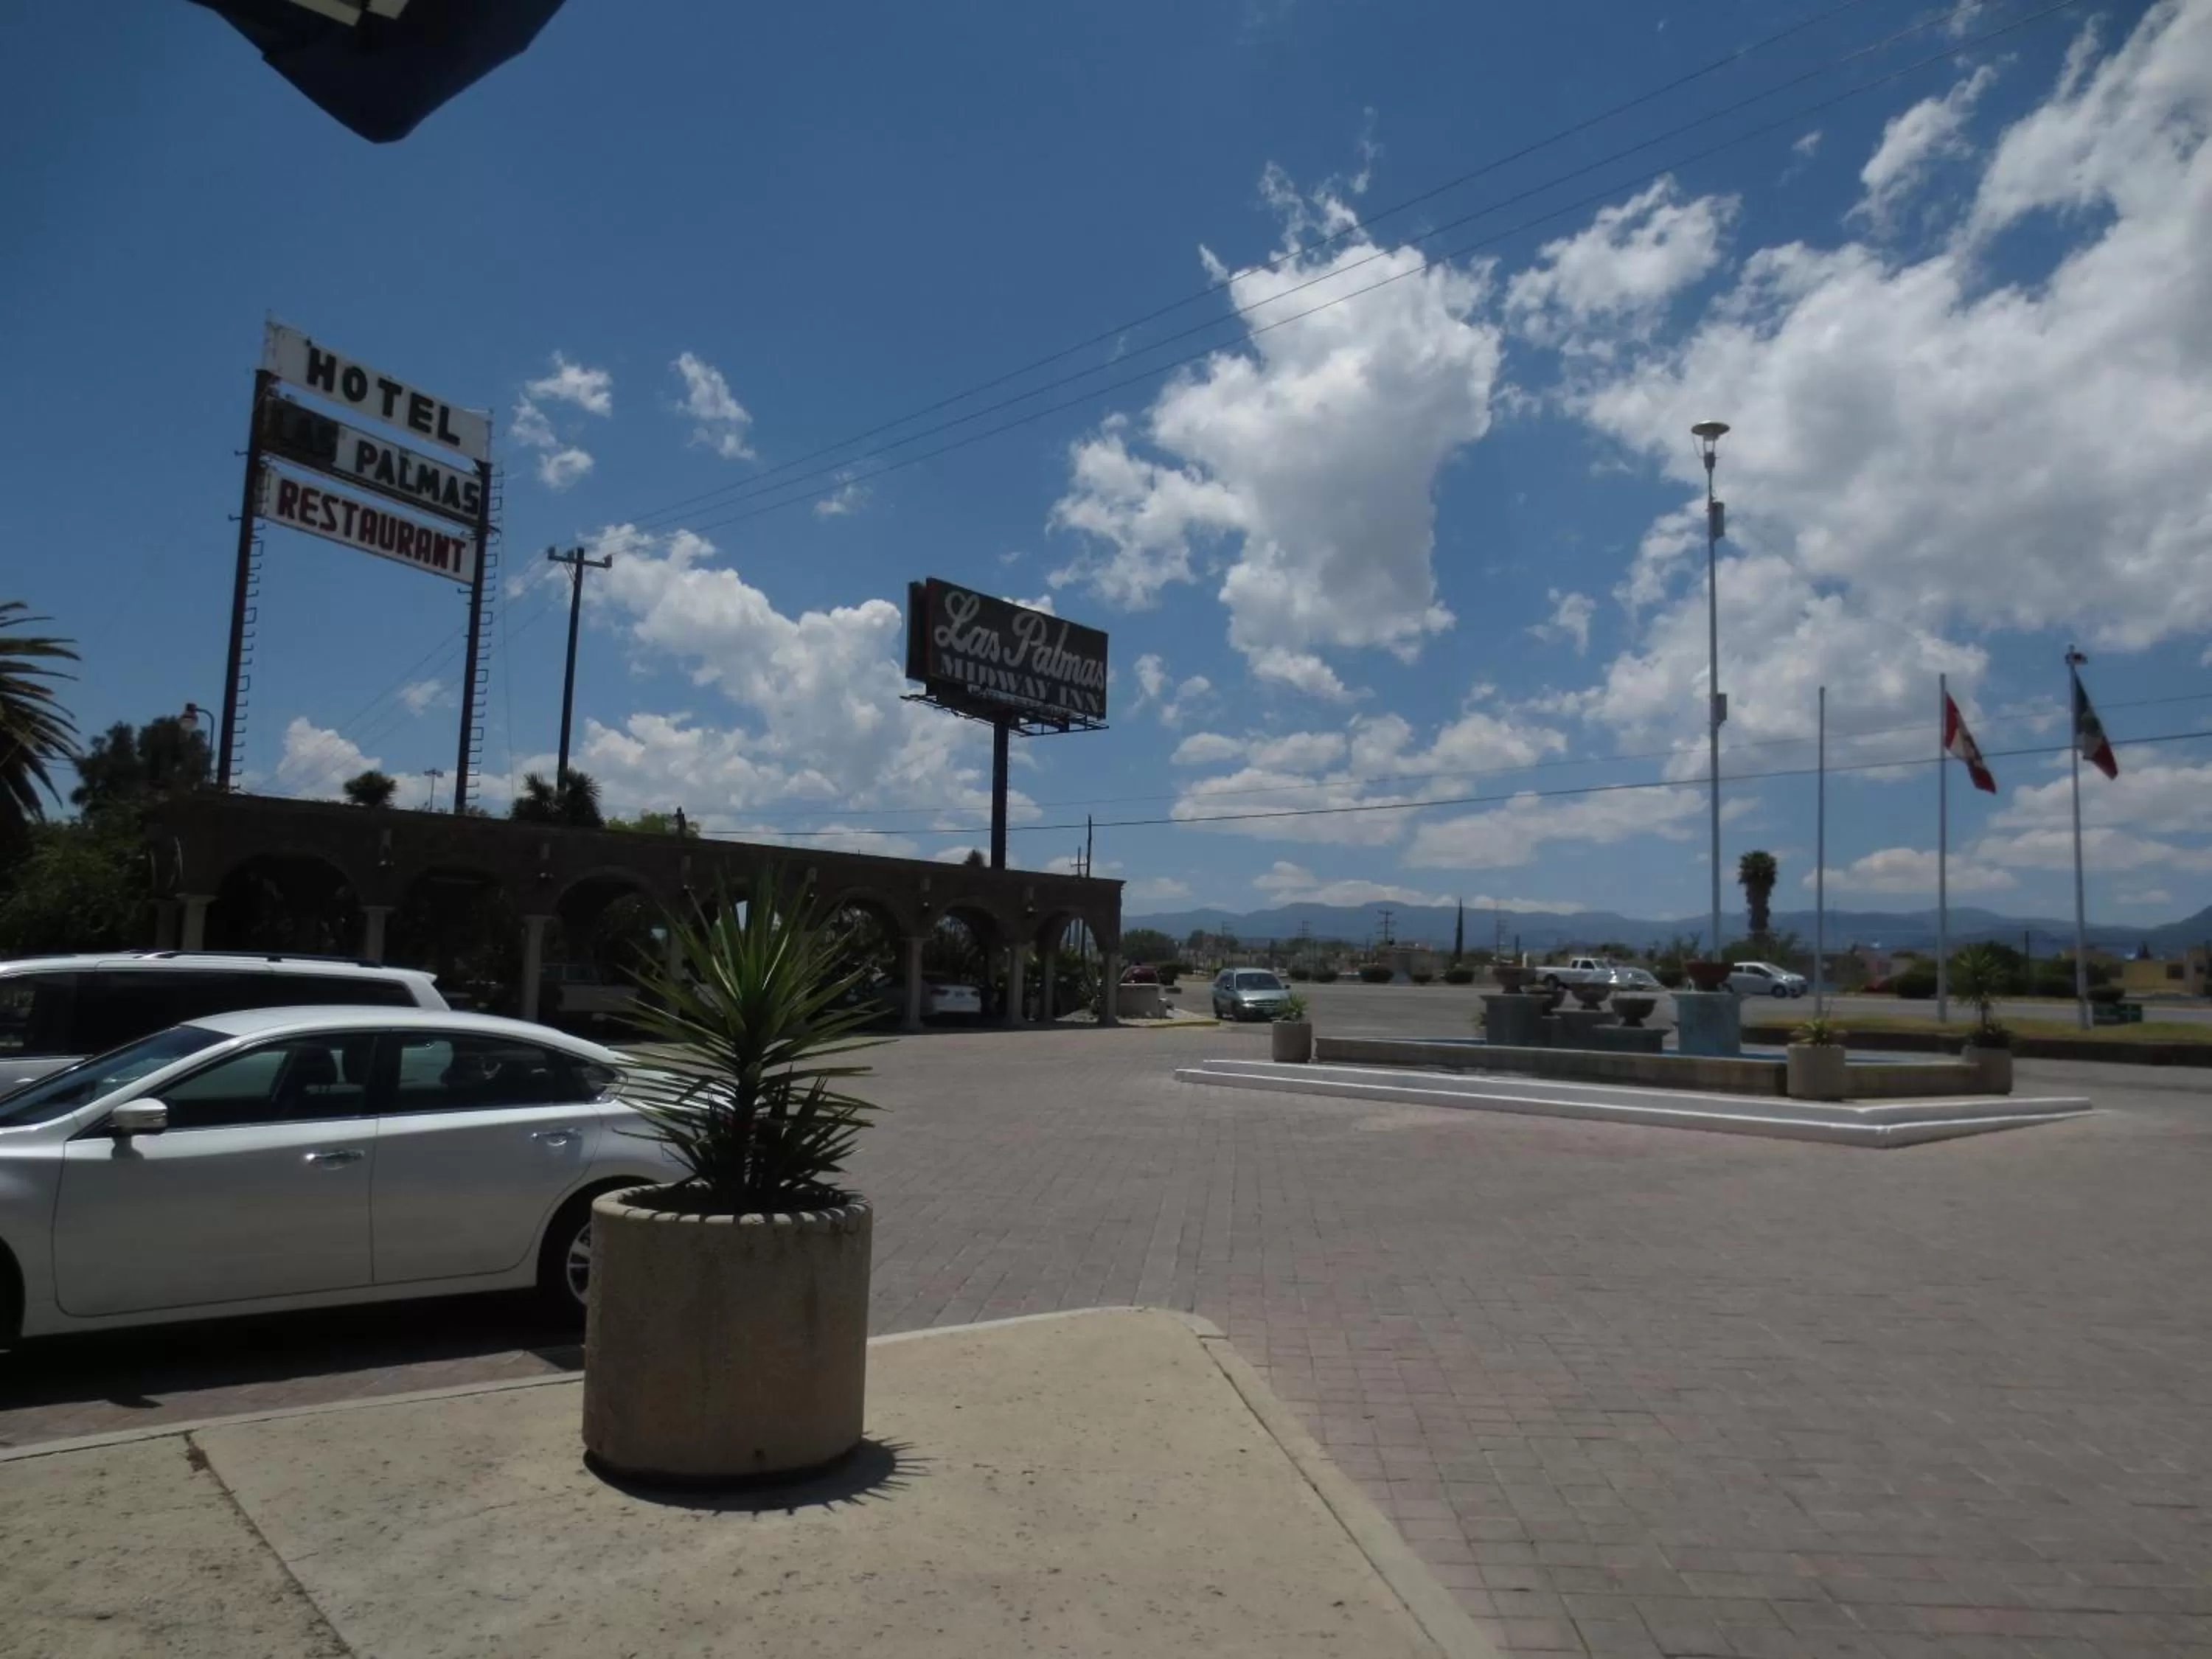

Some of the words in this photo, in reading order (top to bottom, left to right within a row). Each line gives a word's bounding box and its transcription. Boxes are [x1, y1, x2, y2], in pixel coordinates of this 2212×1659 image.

[307, 347, 461, 446] HOTEL
[356, 440, 480, 515] PALMAS
[277, 479, 467, 573] RESTAURANT
[934, 591, 1000, 662] Las
[1004, 611, 1105, 690] Palmas
